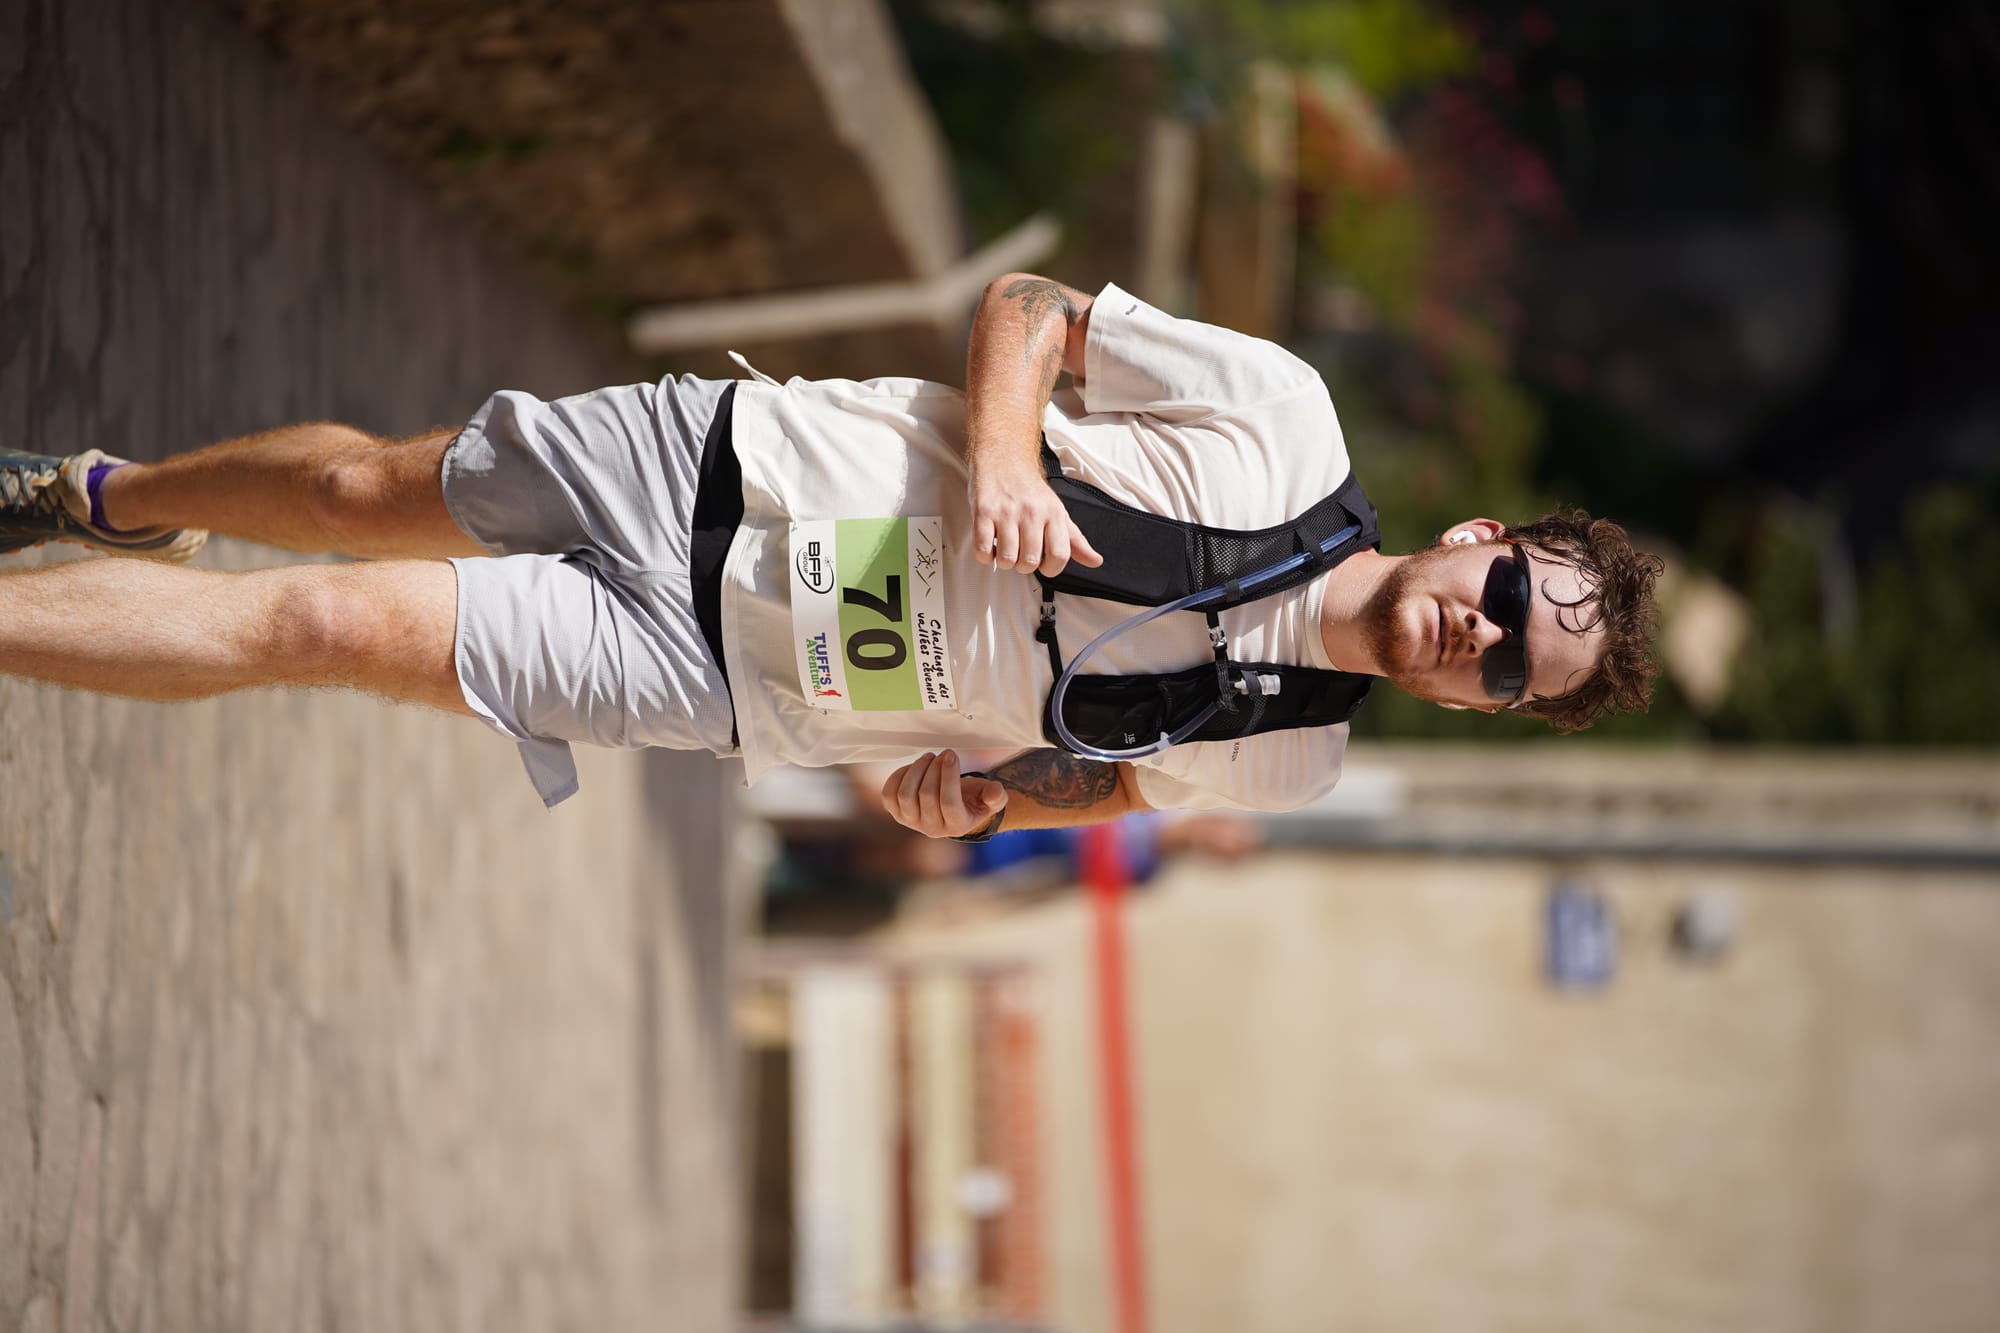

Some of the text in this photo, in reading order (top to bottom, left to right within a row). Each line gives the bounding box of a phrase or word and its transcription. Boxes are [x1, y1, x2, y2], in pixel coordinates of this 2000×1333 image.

[808, 541, 821, 586] BFP
[843, 575, 906, 670] 70
[806, 638, 821, 689] Aventure
[814, 632, 832, 685] TUFF'S
[917, 612, 937, 703] vallées cévenoles
[930, 619, 949, 699] Challenge des
